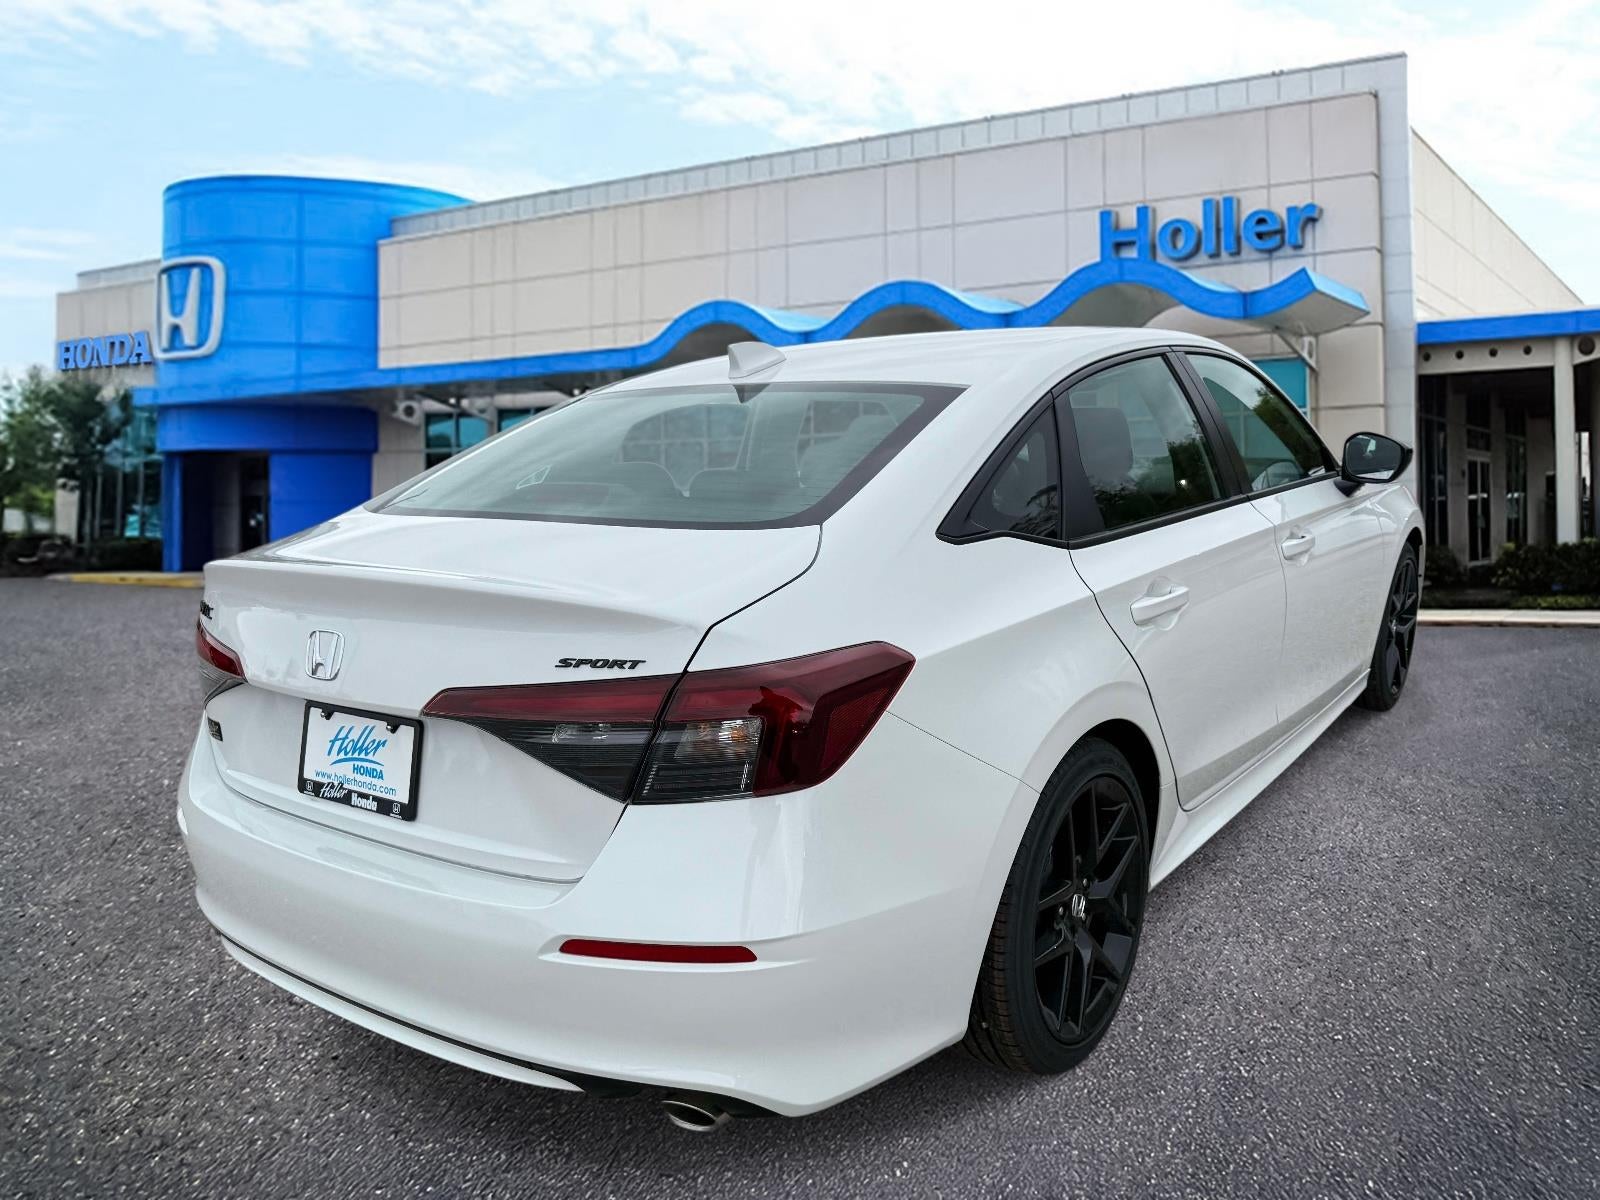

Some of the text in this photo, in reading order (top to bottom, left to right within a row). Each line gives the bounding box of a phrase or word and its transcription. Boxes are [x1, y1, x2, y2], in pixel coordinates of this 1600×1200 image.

[1100, 195, 1323, 260] Holler
[57, 330, 152, 372] HONDA
[555, 657, 647, 670] SPORT
[326, 725, 388, 757] Holler
[352, 763, 384, 781] HONDA
[319, 781, 378, 811] Holler Honda
